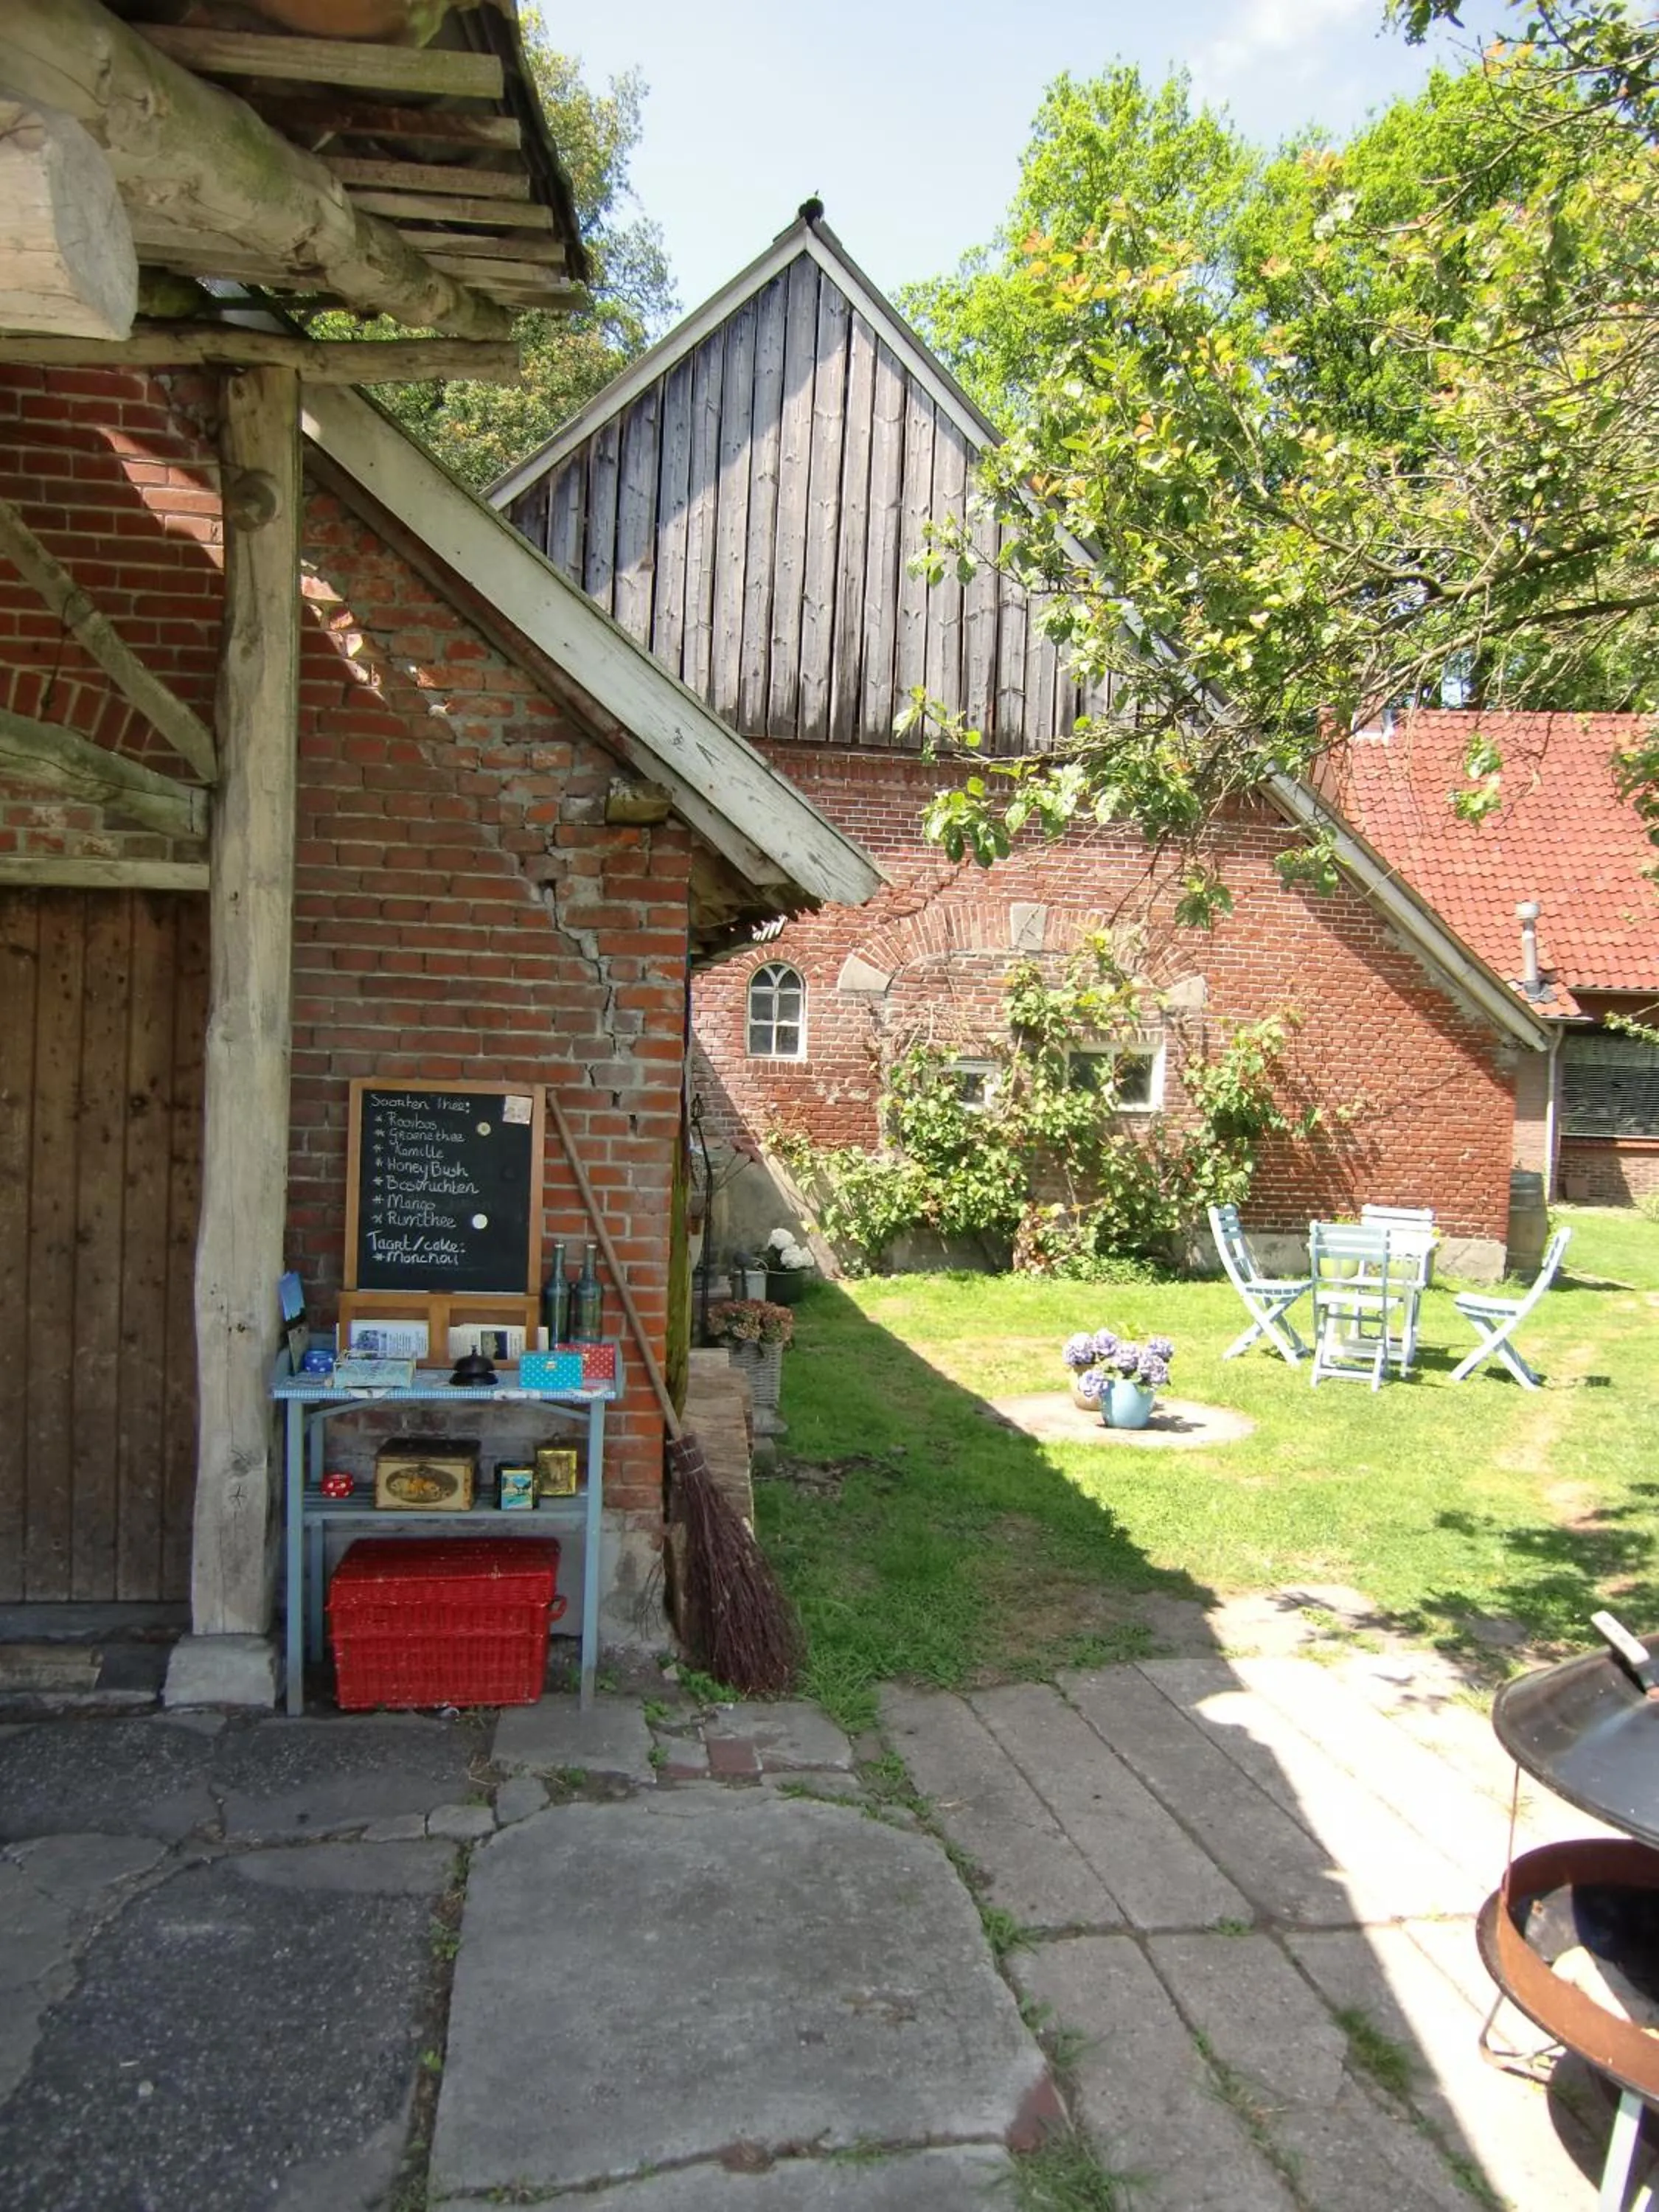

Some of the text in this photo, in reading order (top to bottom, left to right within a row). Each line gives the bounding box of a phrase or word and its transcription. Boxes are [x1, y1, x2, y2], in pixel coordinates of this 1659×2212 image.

[387, 1111, 437, 1130] Rooibos
[394, 1143, 444, 1158] Kamille
[387, 1157, 469, 1180] Honey Bush
[386, 1175, 479, 1194] Bosvruchten
[387, 1194, 436, 1211] Mango
